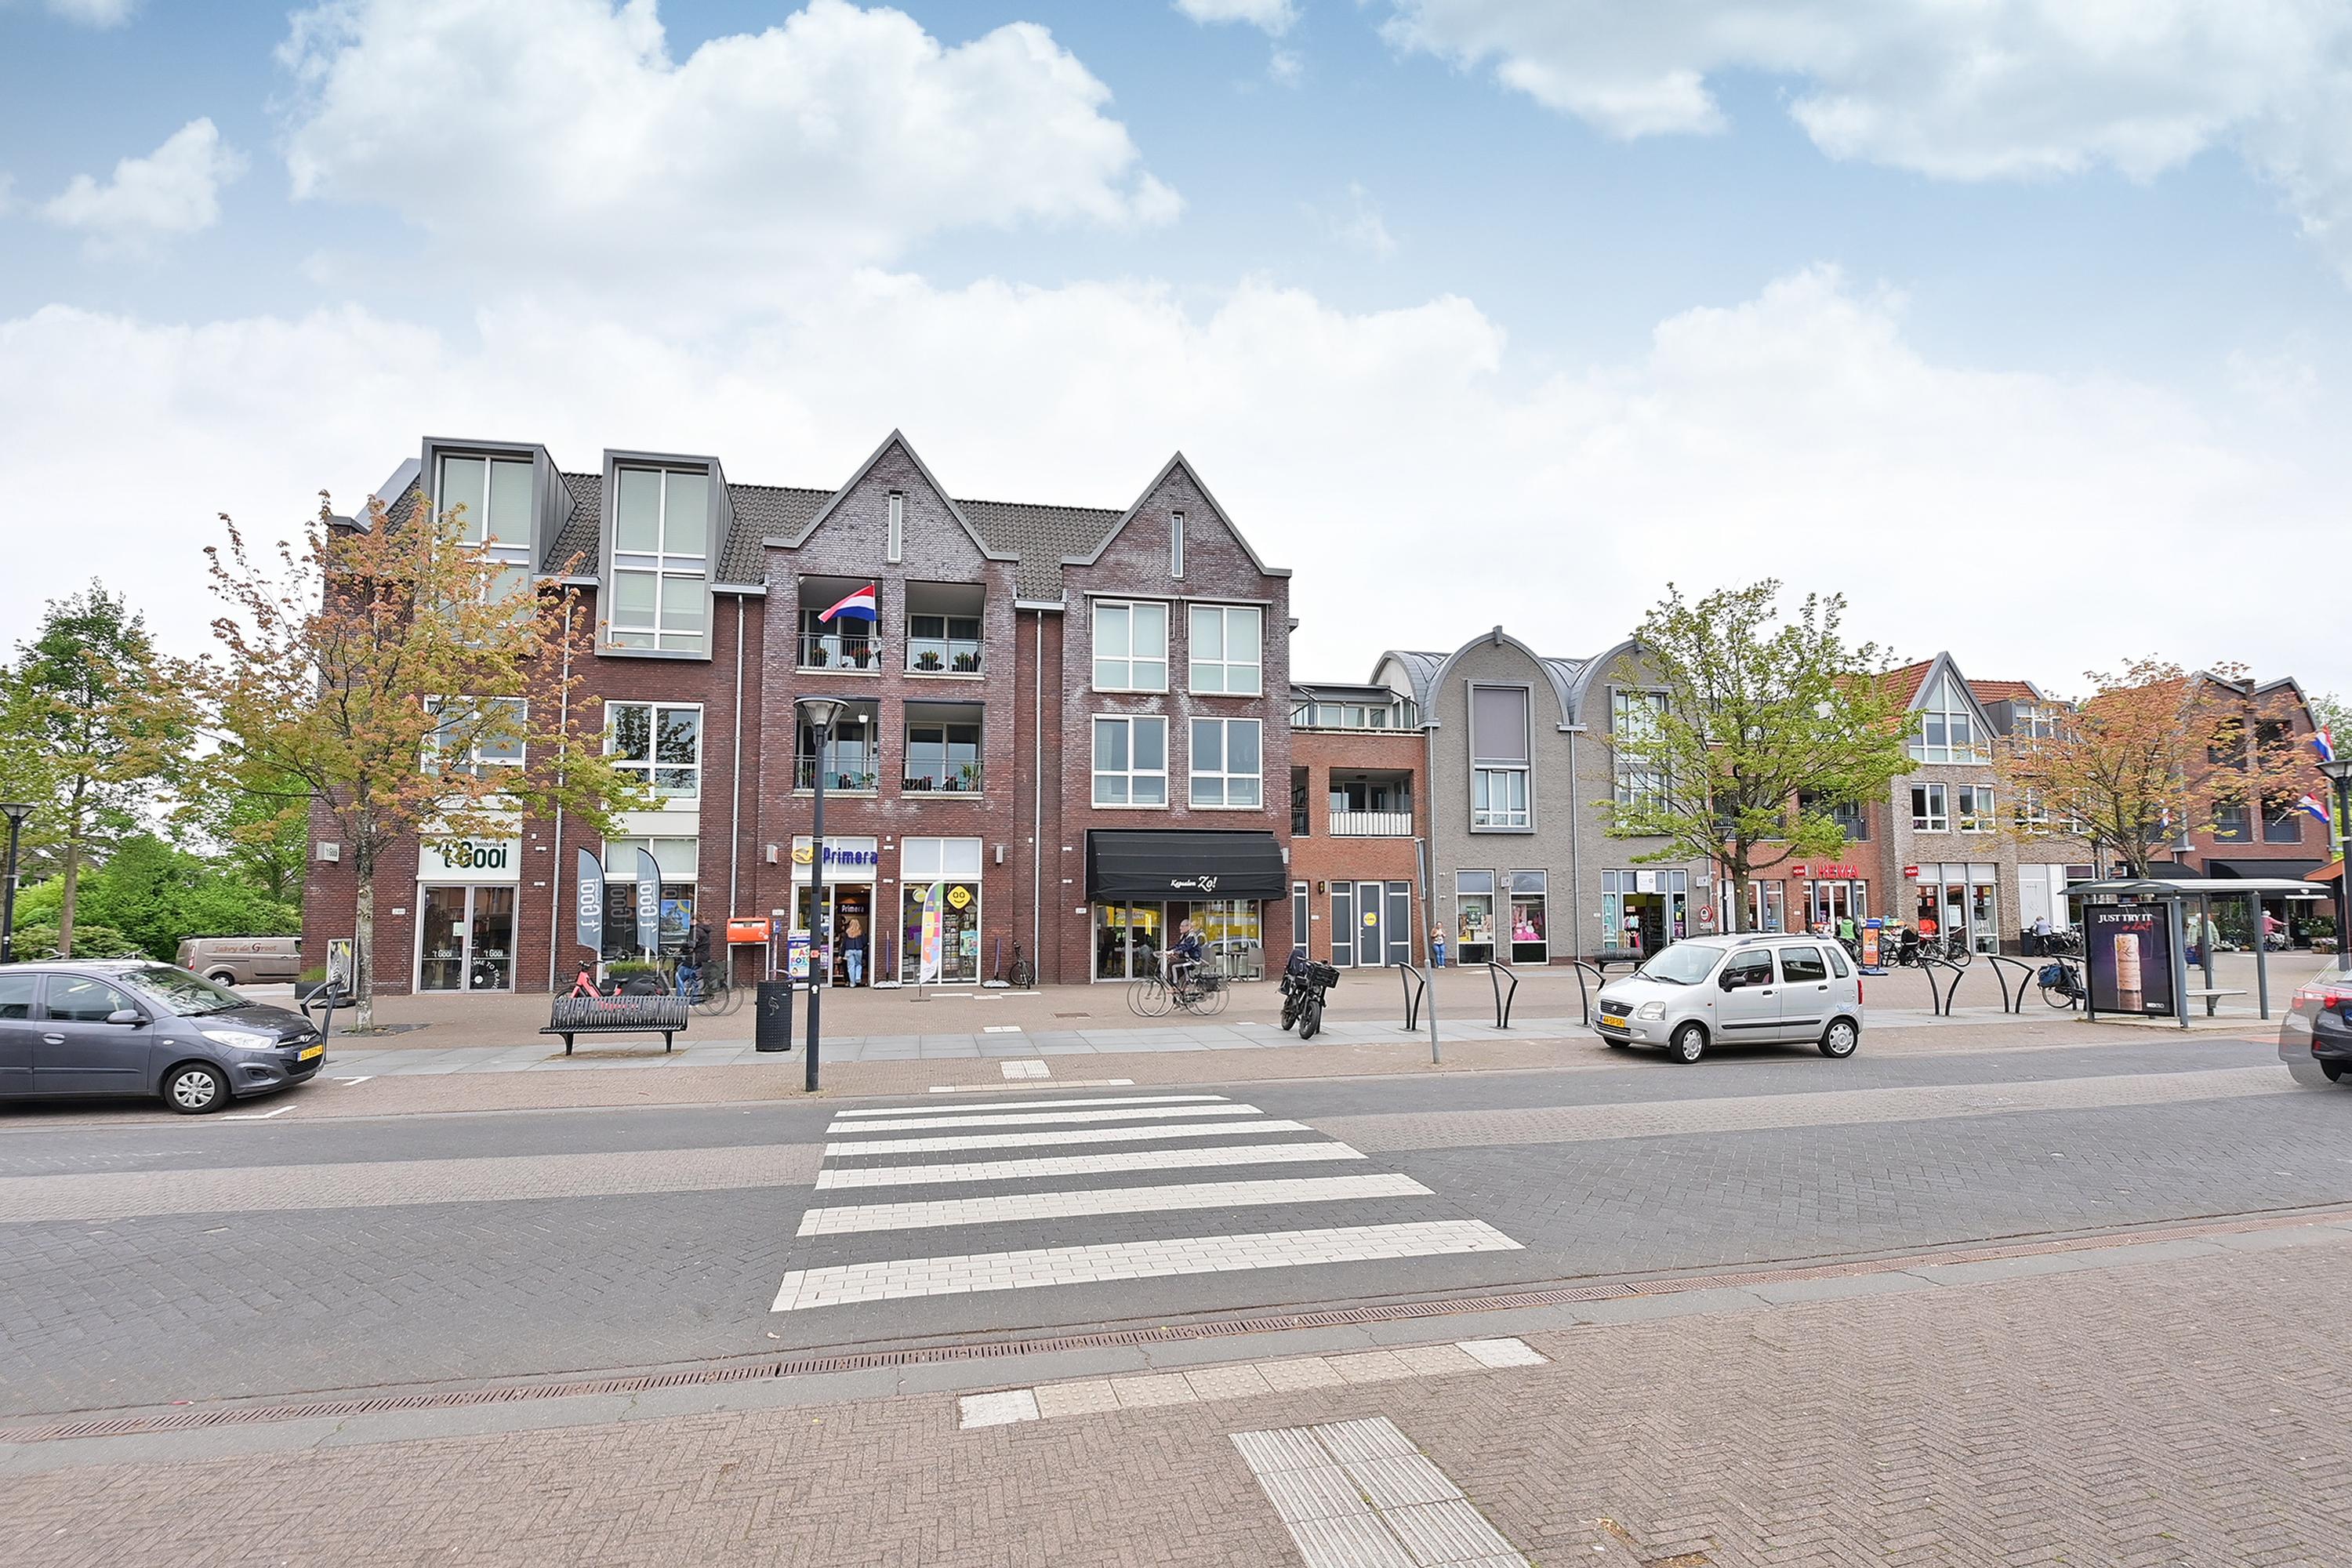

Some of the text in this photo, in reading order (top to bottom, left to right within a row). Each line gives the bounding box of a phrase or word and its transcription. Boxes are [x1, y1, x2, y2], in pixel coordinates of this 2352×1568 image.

[823, 847, 878, 865] Primera
[1817, 865, 1860, 879] HEMA
[1197, 875, 1218, 892] Zo!
[841, 904, 865, 913] Primera
[2097, 913, 2153, 924] JUST TRY IT
[252, 942, 277, 953] Groot
